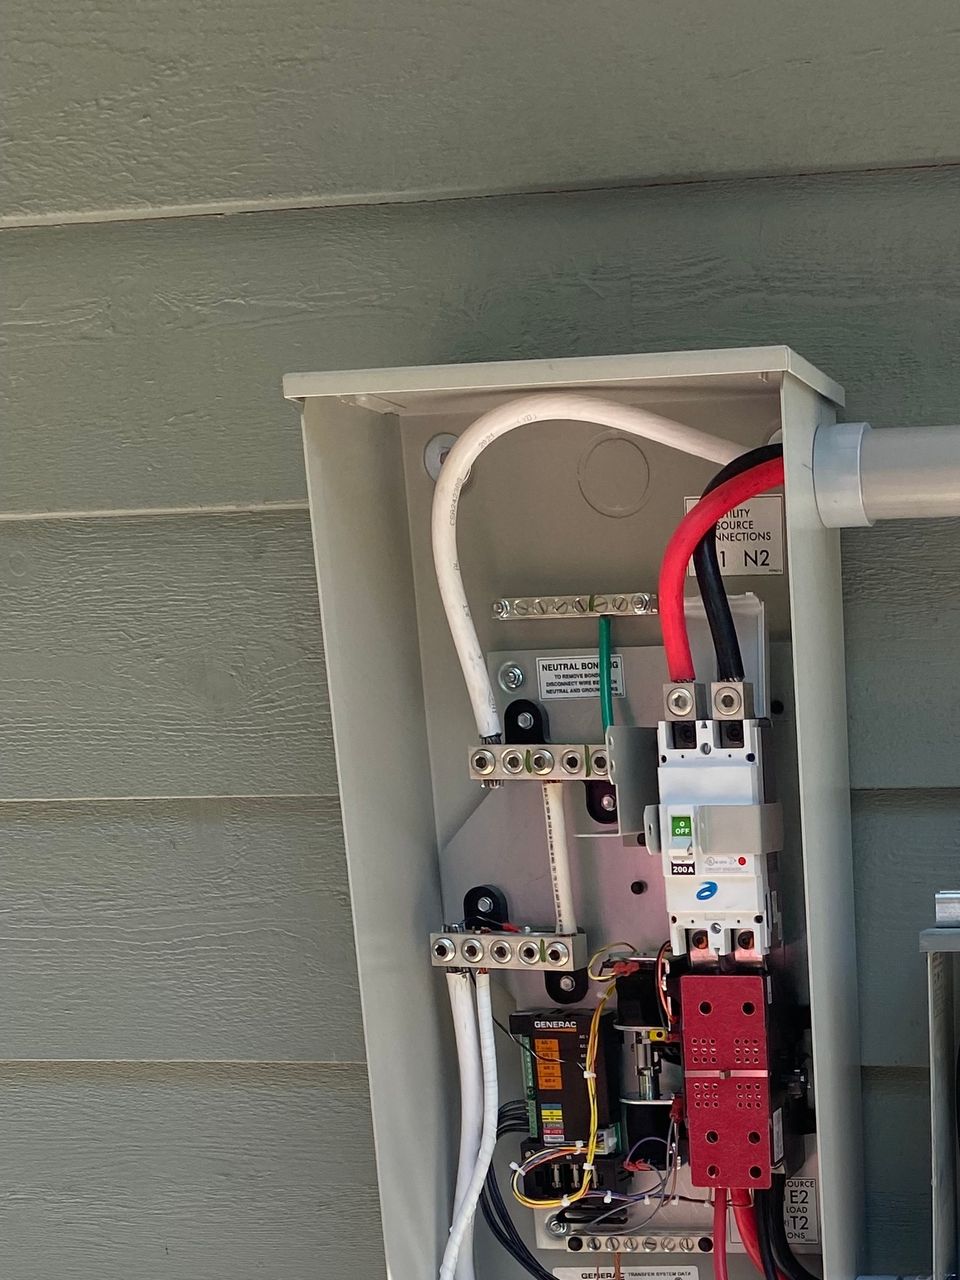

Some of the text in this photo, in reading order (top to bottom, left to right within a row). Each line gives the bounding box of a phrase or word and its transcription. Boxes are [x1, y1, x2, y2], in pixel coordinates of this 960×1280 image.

[716, 520, 754, 530] SOURCE
[715, 531, 772, 542] NNECTIONS
[743, 549, 770, 567] N2
[542, 660, 619, 672] NEUTRAL BONG
[785, 1180, 815, 1188] OURCE
[789, 1189, 809, 1204] E2
[786, 1206, 808, 1214] LOAD
[789, 1215, 809, 1230] T2
